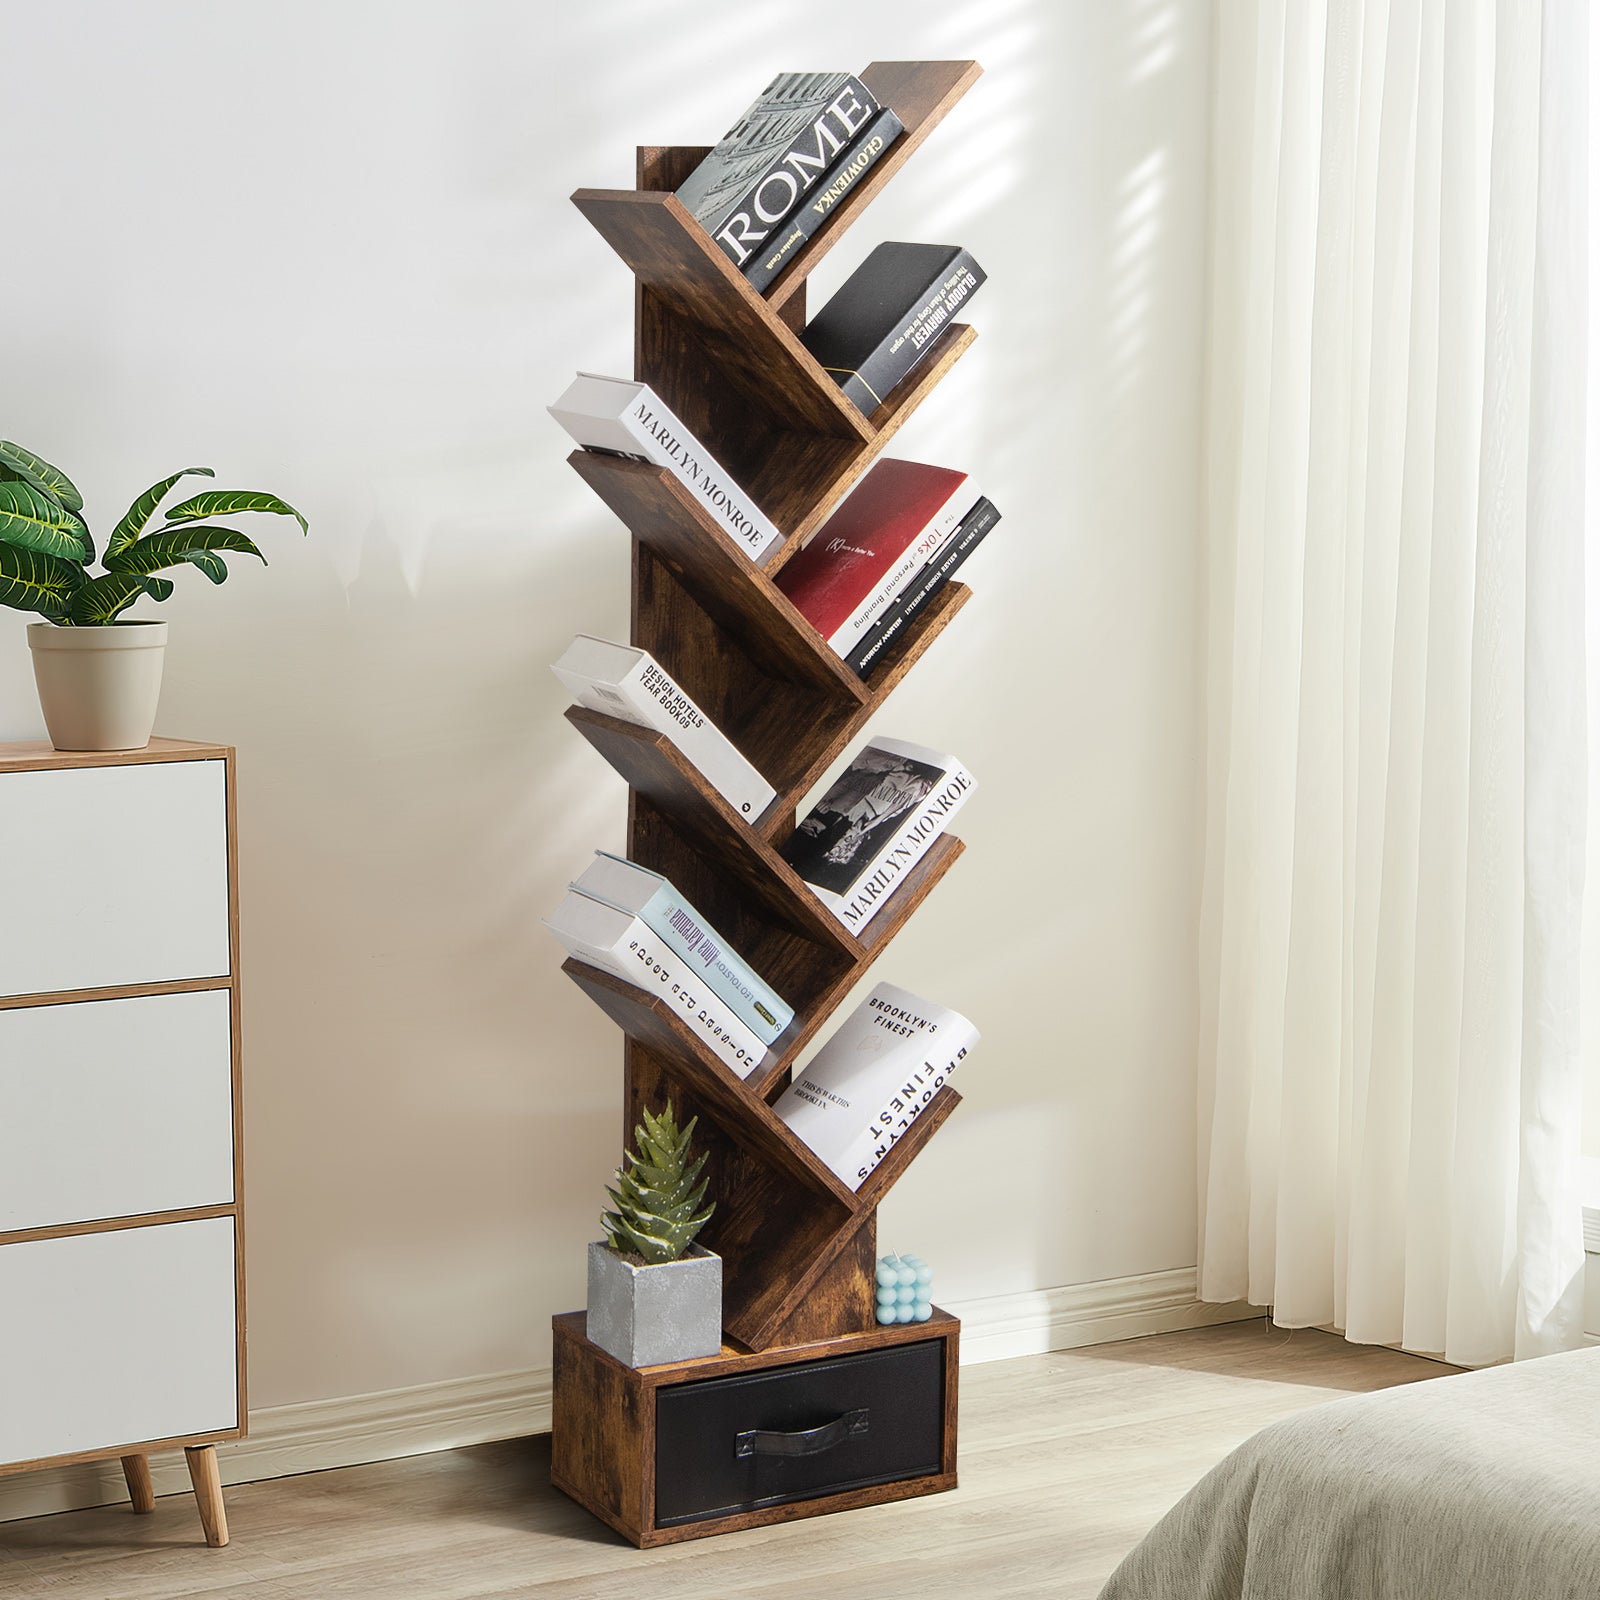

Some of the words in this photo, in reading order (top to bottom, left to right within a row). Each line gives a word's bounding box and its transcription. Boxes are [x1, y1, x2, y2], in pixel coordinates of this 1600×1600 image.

[716, 85, 872, 266] ROME
[956, 266, 968, 276] The
[938, 288, 947, 297] of
[947, 273, 977, 312] BLOODY
[911, 310, 948, 350] HARVEST
[918, 305, 931, 319] Gong
[889, 336, 905, 354] organs
[903, 324, 915, 340] their
[634, 404, 703, 480] MARILYN
[698, 475, 763, 547] MONROE
[917, 528, 942, 555] 10Ks
[884, 559, 915, 597] Personal
[904, 590, 927, 615] INTERIOR
[925, 571, 943, 592] DESIGN
[854, 594, 885, 629] Branding
[639, 672, 660, 698] YEAR
[658, 695, 691, 729] BOOK09
[646, 665, 675, 697] DESIGN
[673, 693, 704, 728] HOTELS
[843, 843, 913, 926] MARILYN
[907, 771, 972, 849] MONROE
[669, 908, 704, 951] Karenina
[697, 941, 722, 968] Anna
[715, 961, 742, 991] TOLSTOY
[740, 984, 755, 1002] LEO
[629, 940, 670, 982] speed
[671, 983, 697, 1009] and
[697, 1009, 753, 1067] passion
[869, 998, 938, 1033] BROOKLYN'S
[874, 1015, 915, 1039] FINEST
[857, 1047, 968, 1180] BROOKLYN'S
[869, 1061, 935, 1140] FINEST
